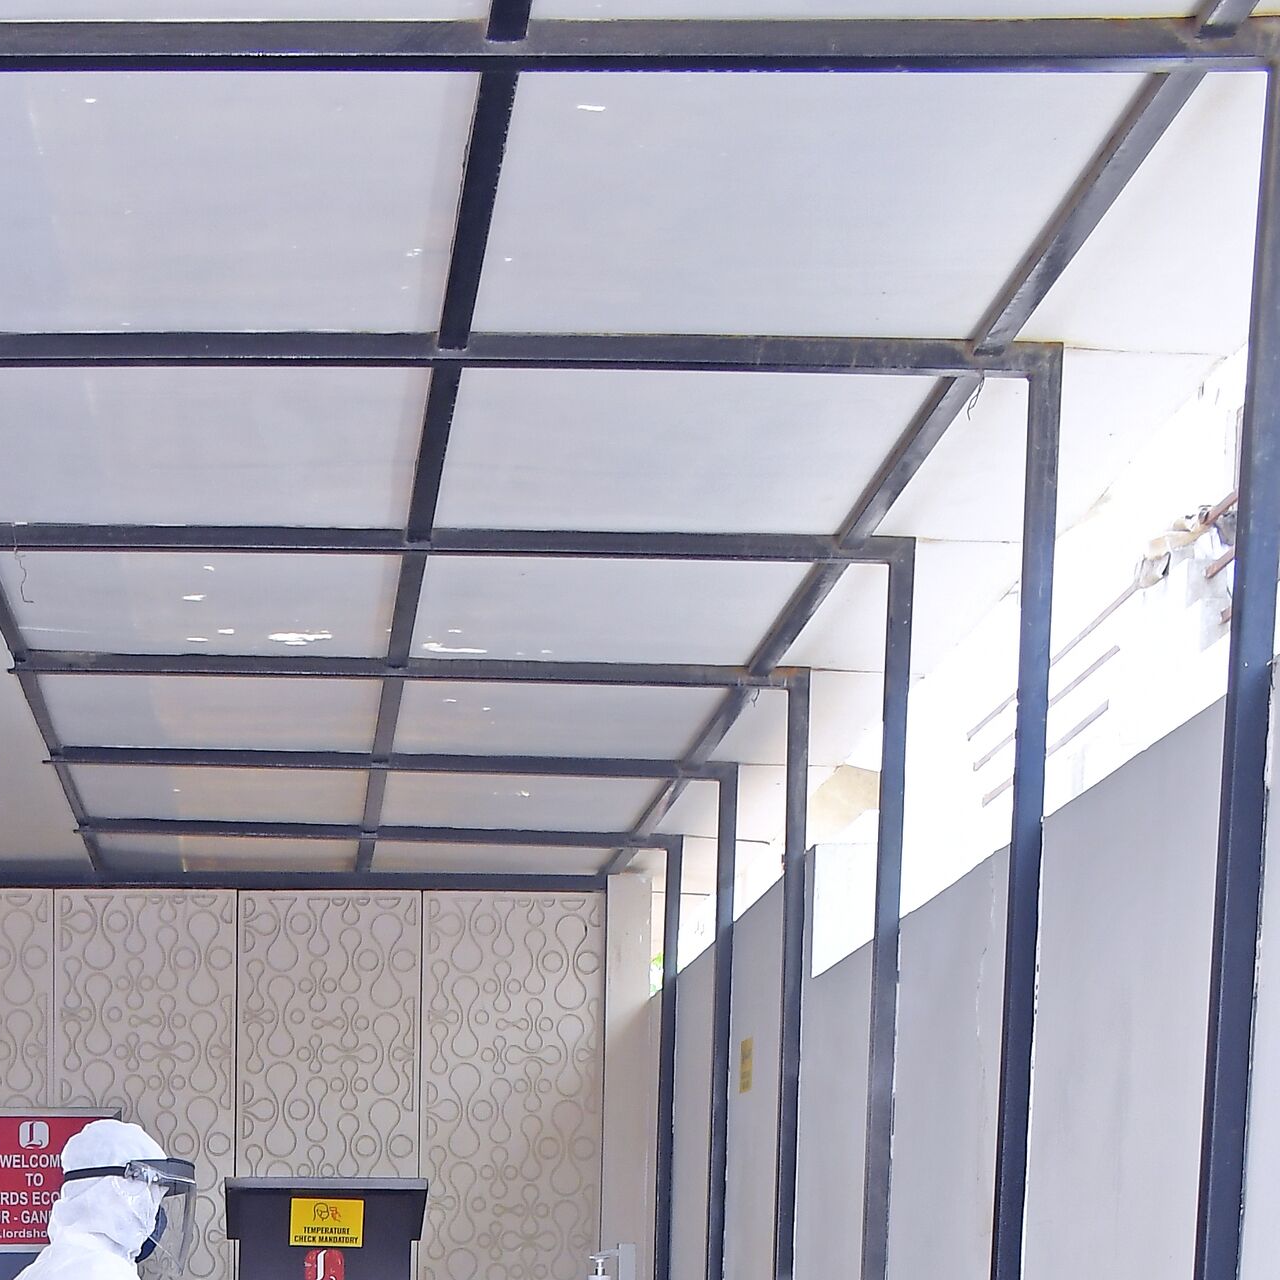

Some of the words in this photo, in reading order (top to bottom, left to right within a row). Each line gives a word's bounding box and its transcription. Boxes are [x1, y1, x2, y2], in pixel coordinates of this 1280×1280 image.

[0, 1154, 60, 1168] WELCOM
[25, 1173, 44, 1187] TO
[32, 1191, 61, 1205] ECO
[21, 1210, 52, 1224] GAN
[303, 1226, 350, 1235] TEMPERATURE
[294, 1235, 317, 1243] CHECK
[318, 1235, 359, 1244] MANDATORY
